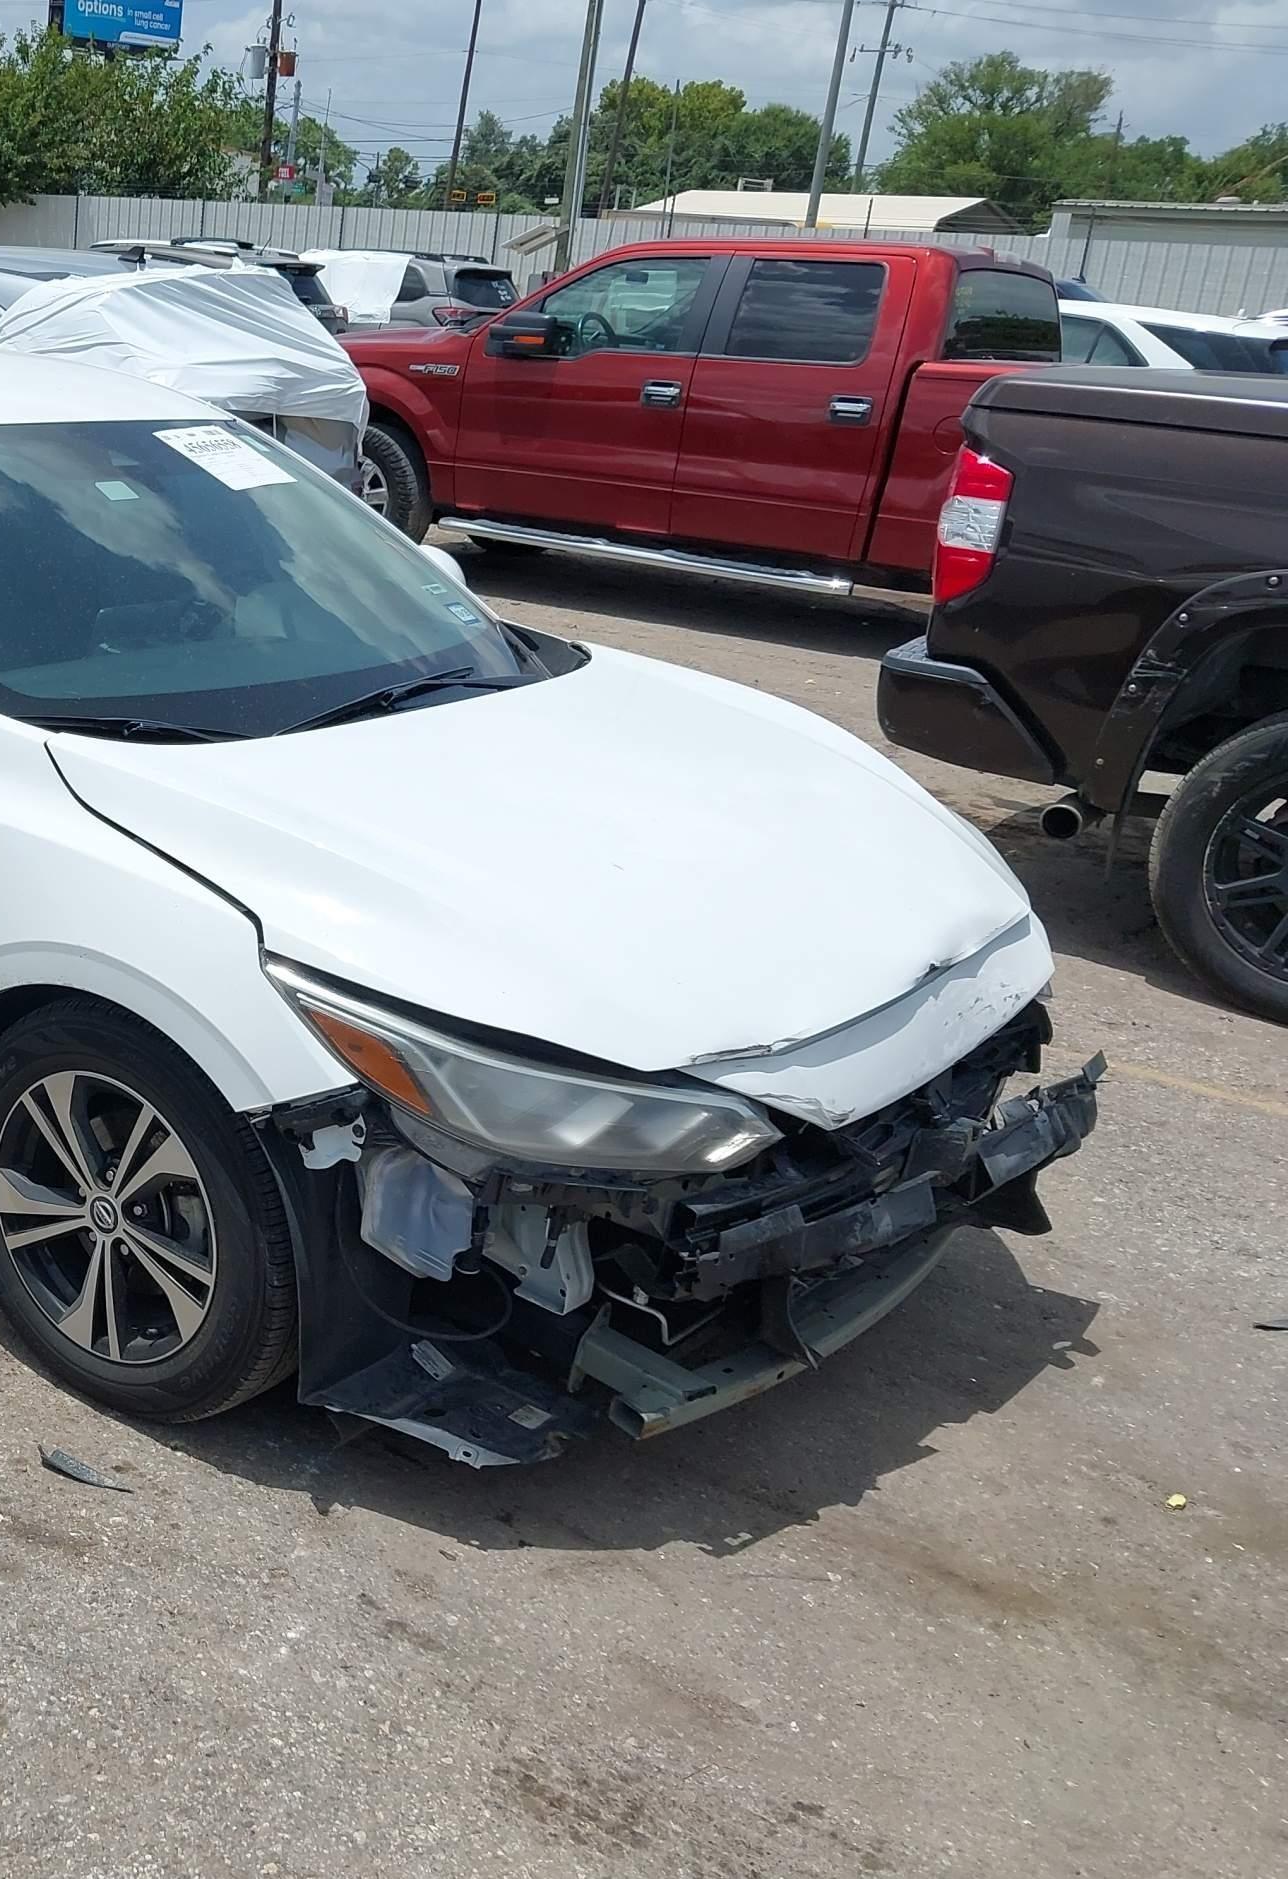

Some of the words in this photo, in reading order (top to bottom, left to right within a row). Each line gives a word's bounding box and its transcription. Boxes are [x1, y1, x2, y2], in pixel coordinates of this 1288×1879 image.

[77, 0, 124, 17] options
[134, 10, 152, 20] small
[152, 12, 164, 21] cell
[134, 18, 149, 30] lung
[149, 21, 171, 31] cancer
